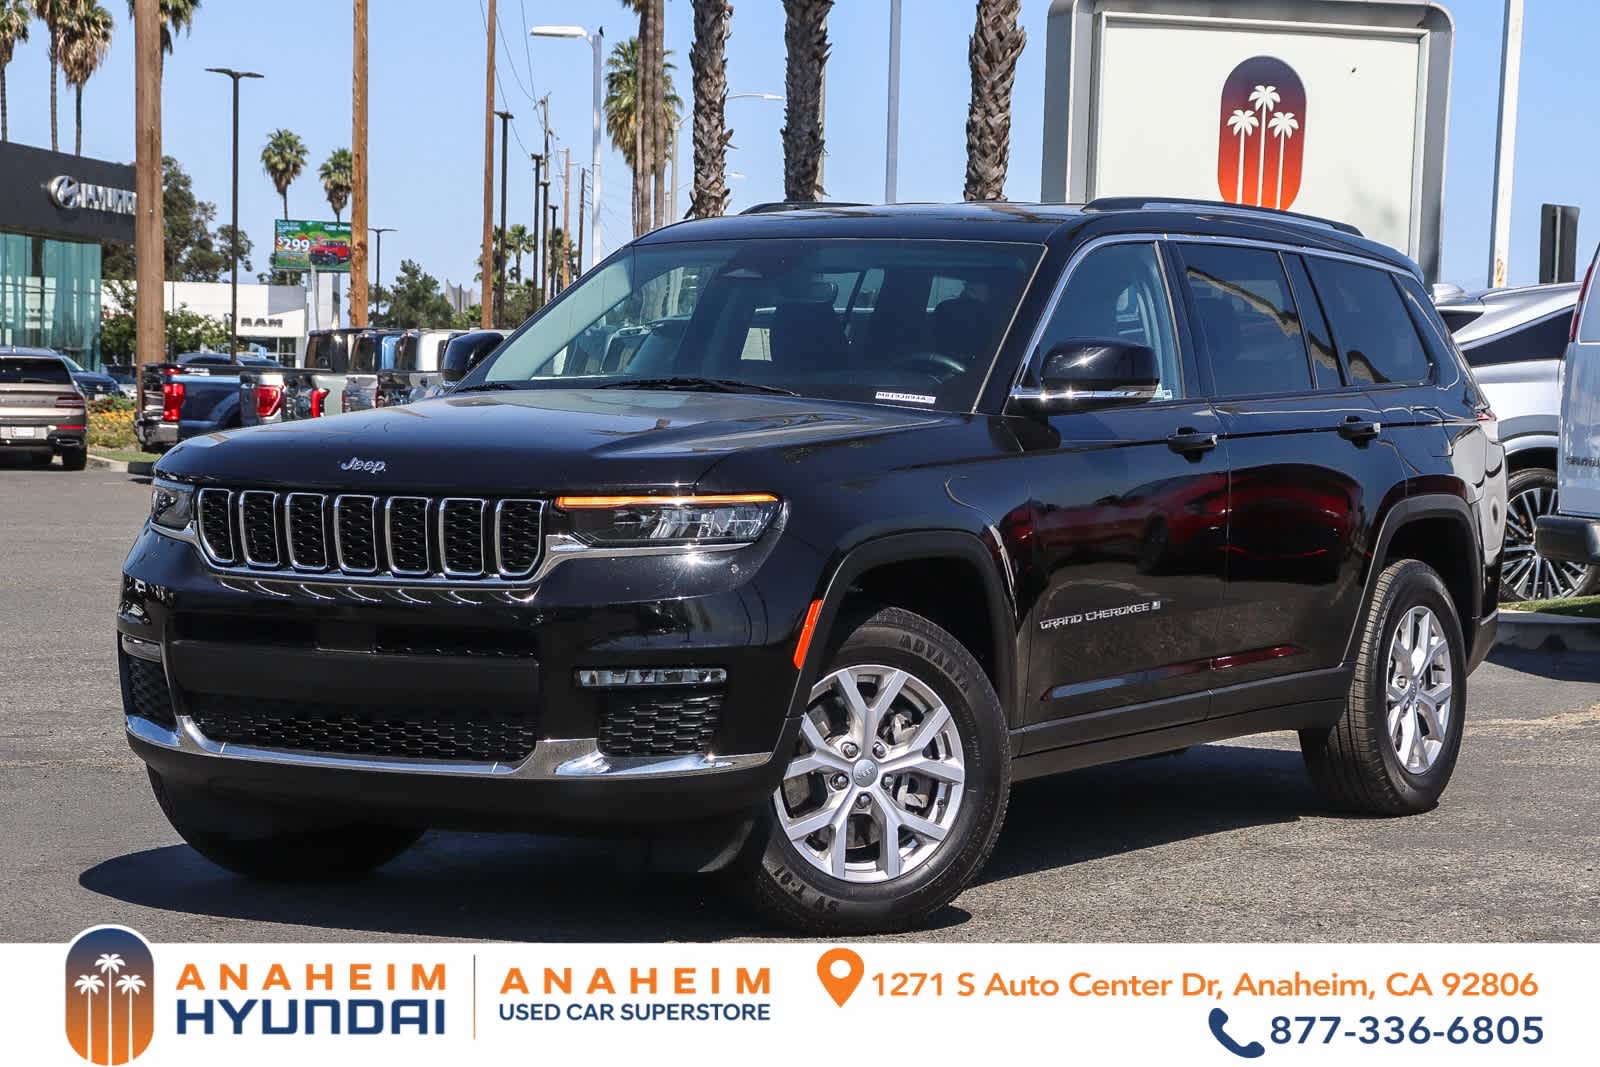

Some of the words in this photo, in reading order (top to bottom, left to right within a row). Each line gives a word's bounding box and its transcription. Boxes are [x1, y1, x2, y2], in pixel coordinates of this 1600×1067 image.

[81, 183, 137, 215] HYUND
[276, 236, 311, 252] $299
[240, 317, 284, 328] RAM
[340, 456, 386, 474] Jeep
[1039, 614, 1083, 630] GRAND
[1085, 602, 1151, 622] CHEROKEE
